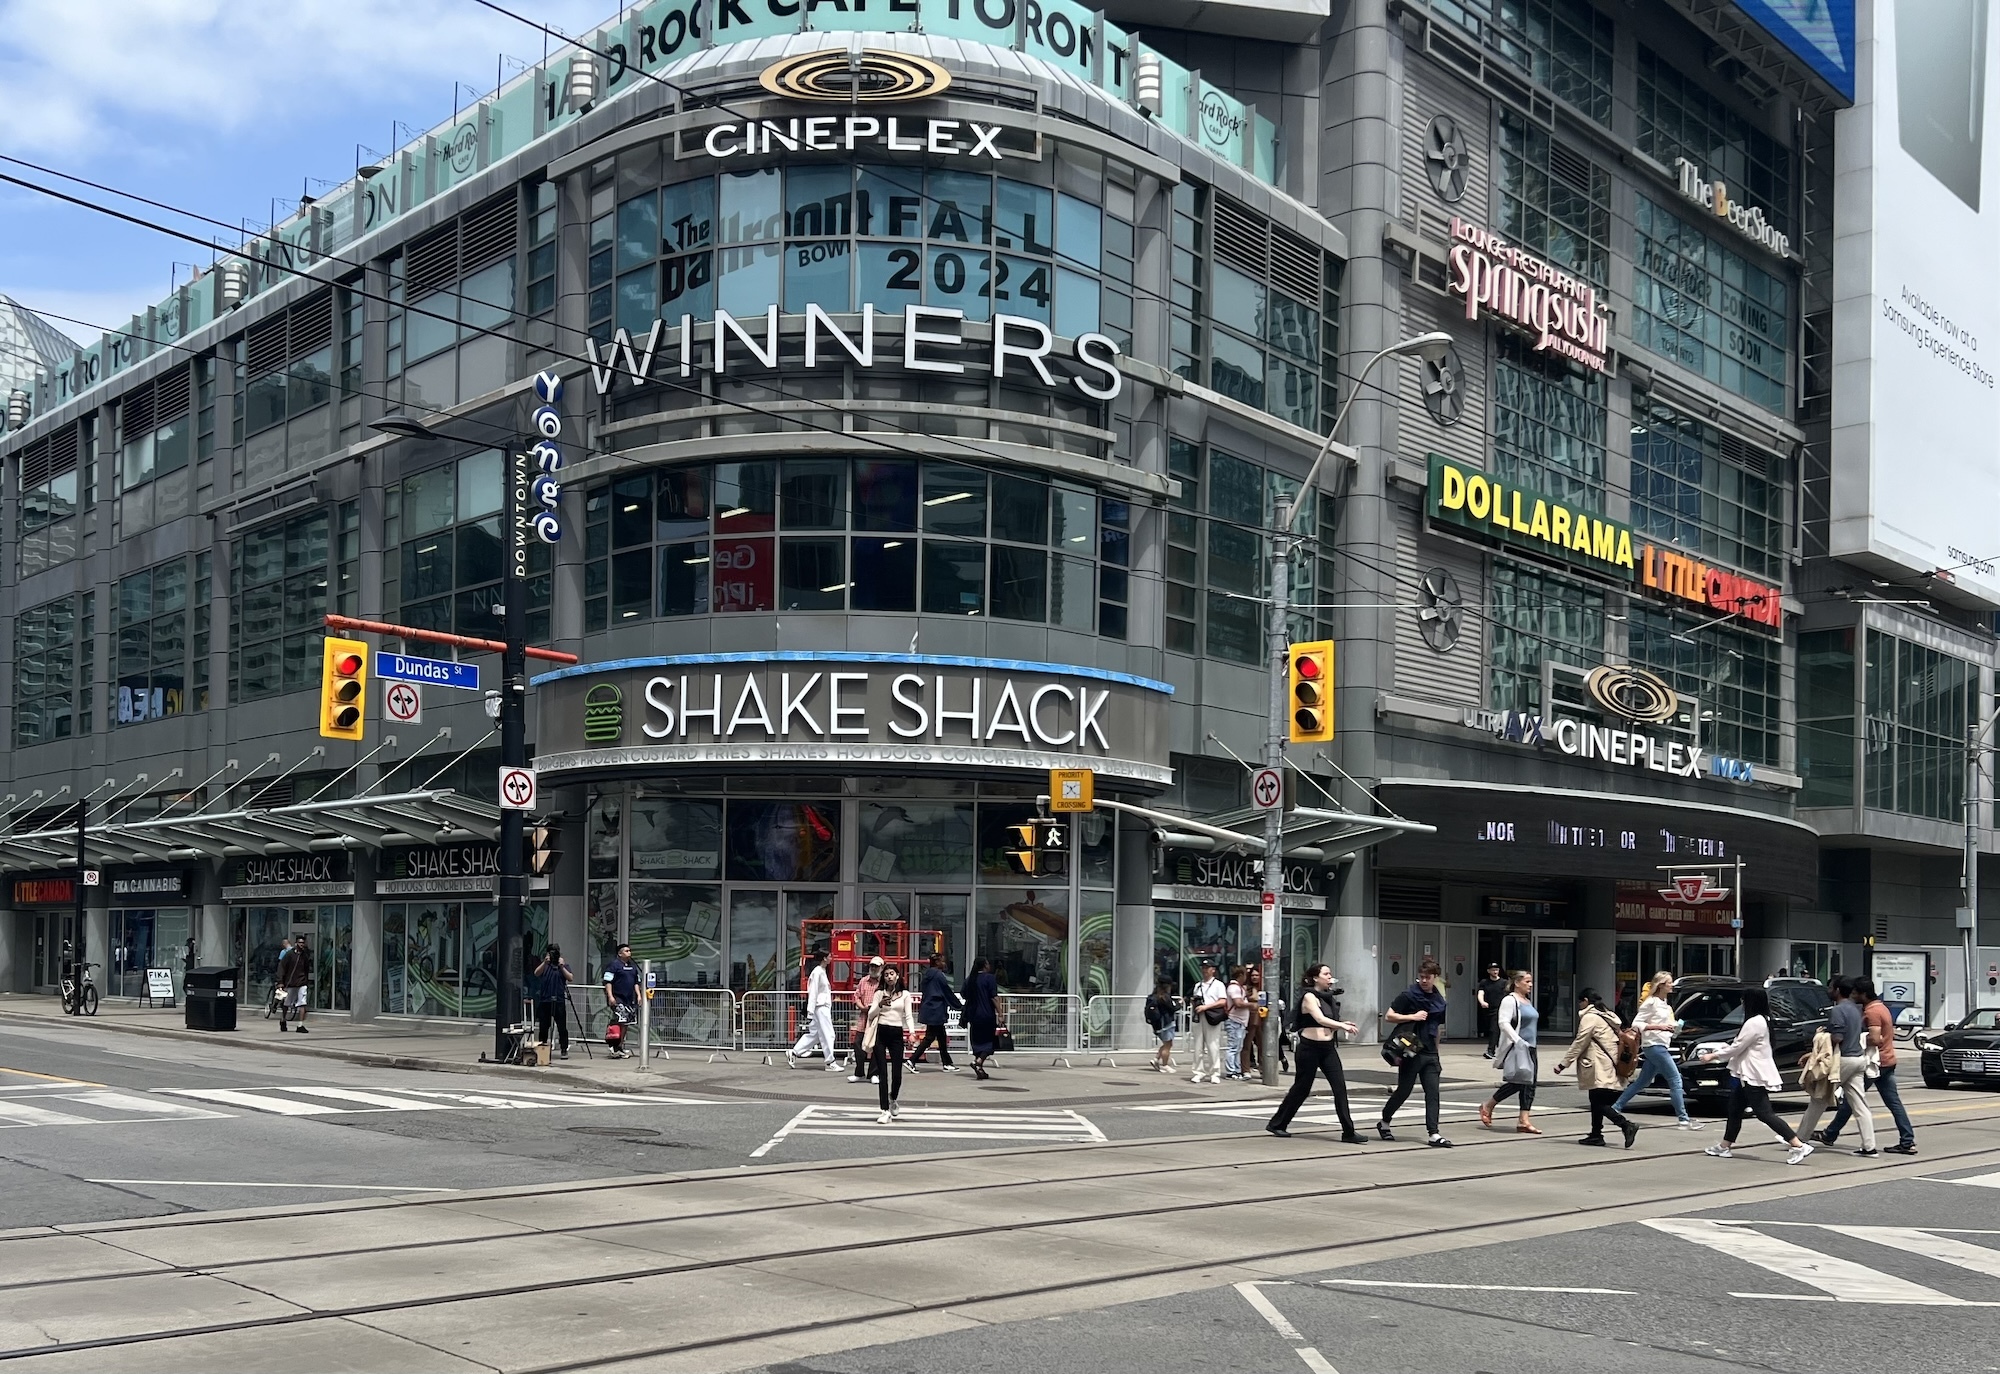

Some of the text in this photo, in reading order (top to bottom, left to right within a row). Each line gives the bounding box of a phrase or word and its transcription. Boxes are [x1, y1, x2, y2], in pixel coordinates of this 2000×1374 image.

[1200, 101, 1241, 136] ard Rock
[1209, 125, 1222, 137] CAFE
[705, 116, 1003, 160] CINEPLEX
[1675, 156, 1789, 258] The Beer Store
[671, 213, 711, 252] The
[889, 196, 1053, 256] FALL
[1451, 217, 1588, 302] LOUNGE RESTAURANT
[887, 249, 1049, 308] 2024
[1723, 291, 1767, 335] COMING
[1901, 284, 1977, 352] Available now at a
[586, 302, 1121, 400] WINNERS
[1729, 330, 1761, 365] SOON
[1883, 298, 1994, 389] Samsung Experience Store
[515, 453, 527, 577] DOWNTOWN
[1442, 464, 1634, 570] DOLLARAMA
[1947, 545, 1995, 577] samsung.com
[1706, 567, 1781, 628] CANADA
[395, 657, 463, 680] Dundas St
[641, 672, 1110, 749] SHAKE SHACK
[581, 751, 628, 766] FROZEN
[631, 747, 698, 762] CUSTARD
[705, 744, 750, 760] FRIES
[759, 744, 828, 759] SHAKES
[837, 745, 873, 760] HOT
[880, 746, 931, 761] DOGS
[942, 749, 1043, 767] CONCRETES
[1104, 761, 1134, 777] BEER
[1139, 766, 1162, 781] WINE
[1553, 718, 1703, 779] CINEPLEX
[1711, 755, 1754, 783] IMAX
[1057, 801, 1086, 809] CROSSING
[246, 856, 332, 883] SHAKE SHACK
[408, 847, 501, 876] SHAKE SHAC
[640, 856, 711, 865] SHAKE SHACK
[1196, 857, 1255, 887] SHAKE
[38, 879, 74, 903] CANADA
[113, 877, 181, 894] FIKA CANNABIS
[321, 884, 348, 894] SHAKES
[385, 881, 400, 893] HOT
[401, 881, 424, 892] DOGS
[425, 879, 473, 892] CONCRETES
[1173, 887, 1215, 902] BURGERS
[1217, 891, 1250, 904] FROZEN
[1291, 897, 1314, 908] FRIES
[1501, 901, 1526, 914] Dundas
[1615, 903, 1646, 920] CANADA
[148, 971, 170, 979] FIKA
[1908, 1014, 1923, 1023] Bell
